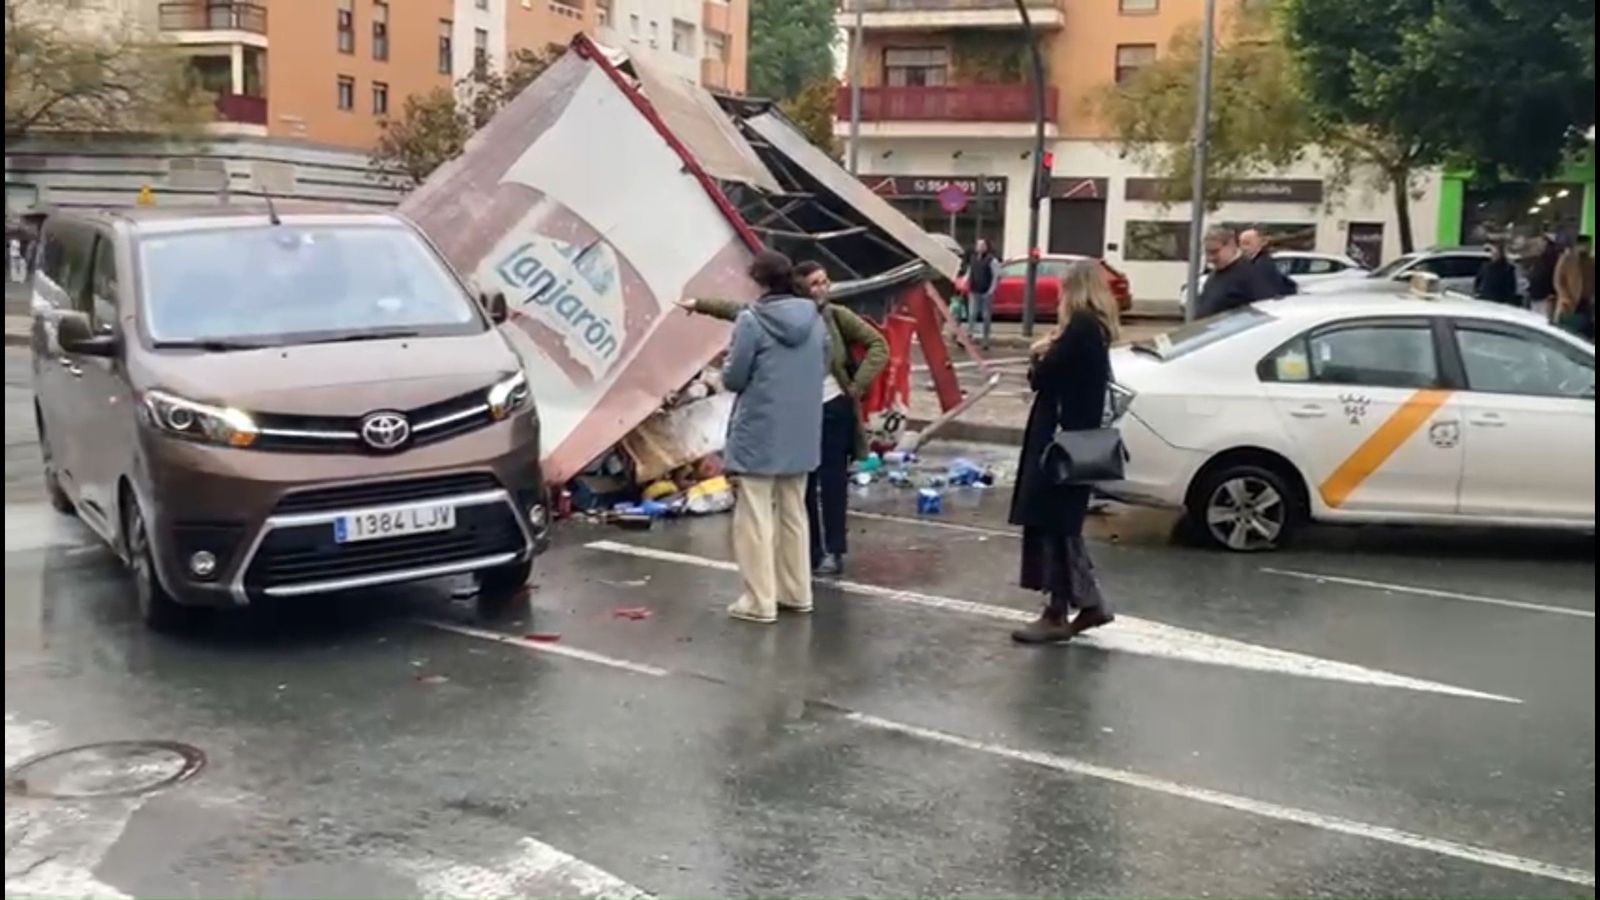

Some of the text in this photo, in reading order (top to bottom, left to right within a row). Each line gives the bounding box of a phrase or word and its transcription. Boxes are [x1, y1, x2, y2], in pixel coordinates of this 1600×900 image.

[496, 242, 617, 359] Lanjarón
[355, 505, 450, 537] 1384 LJV
